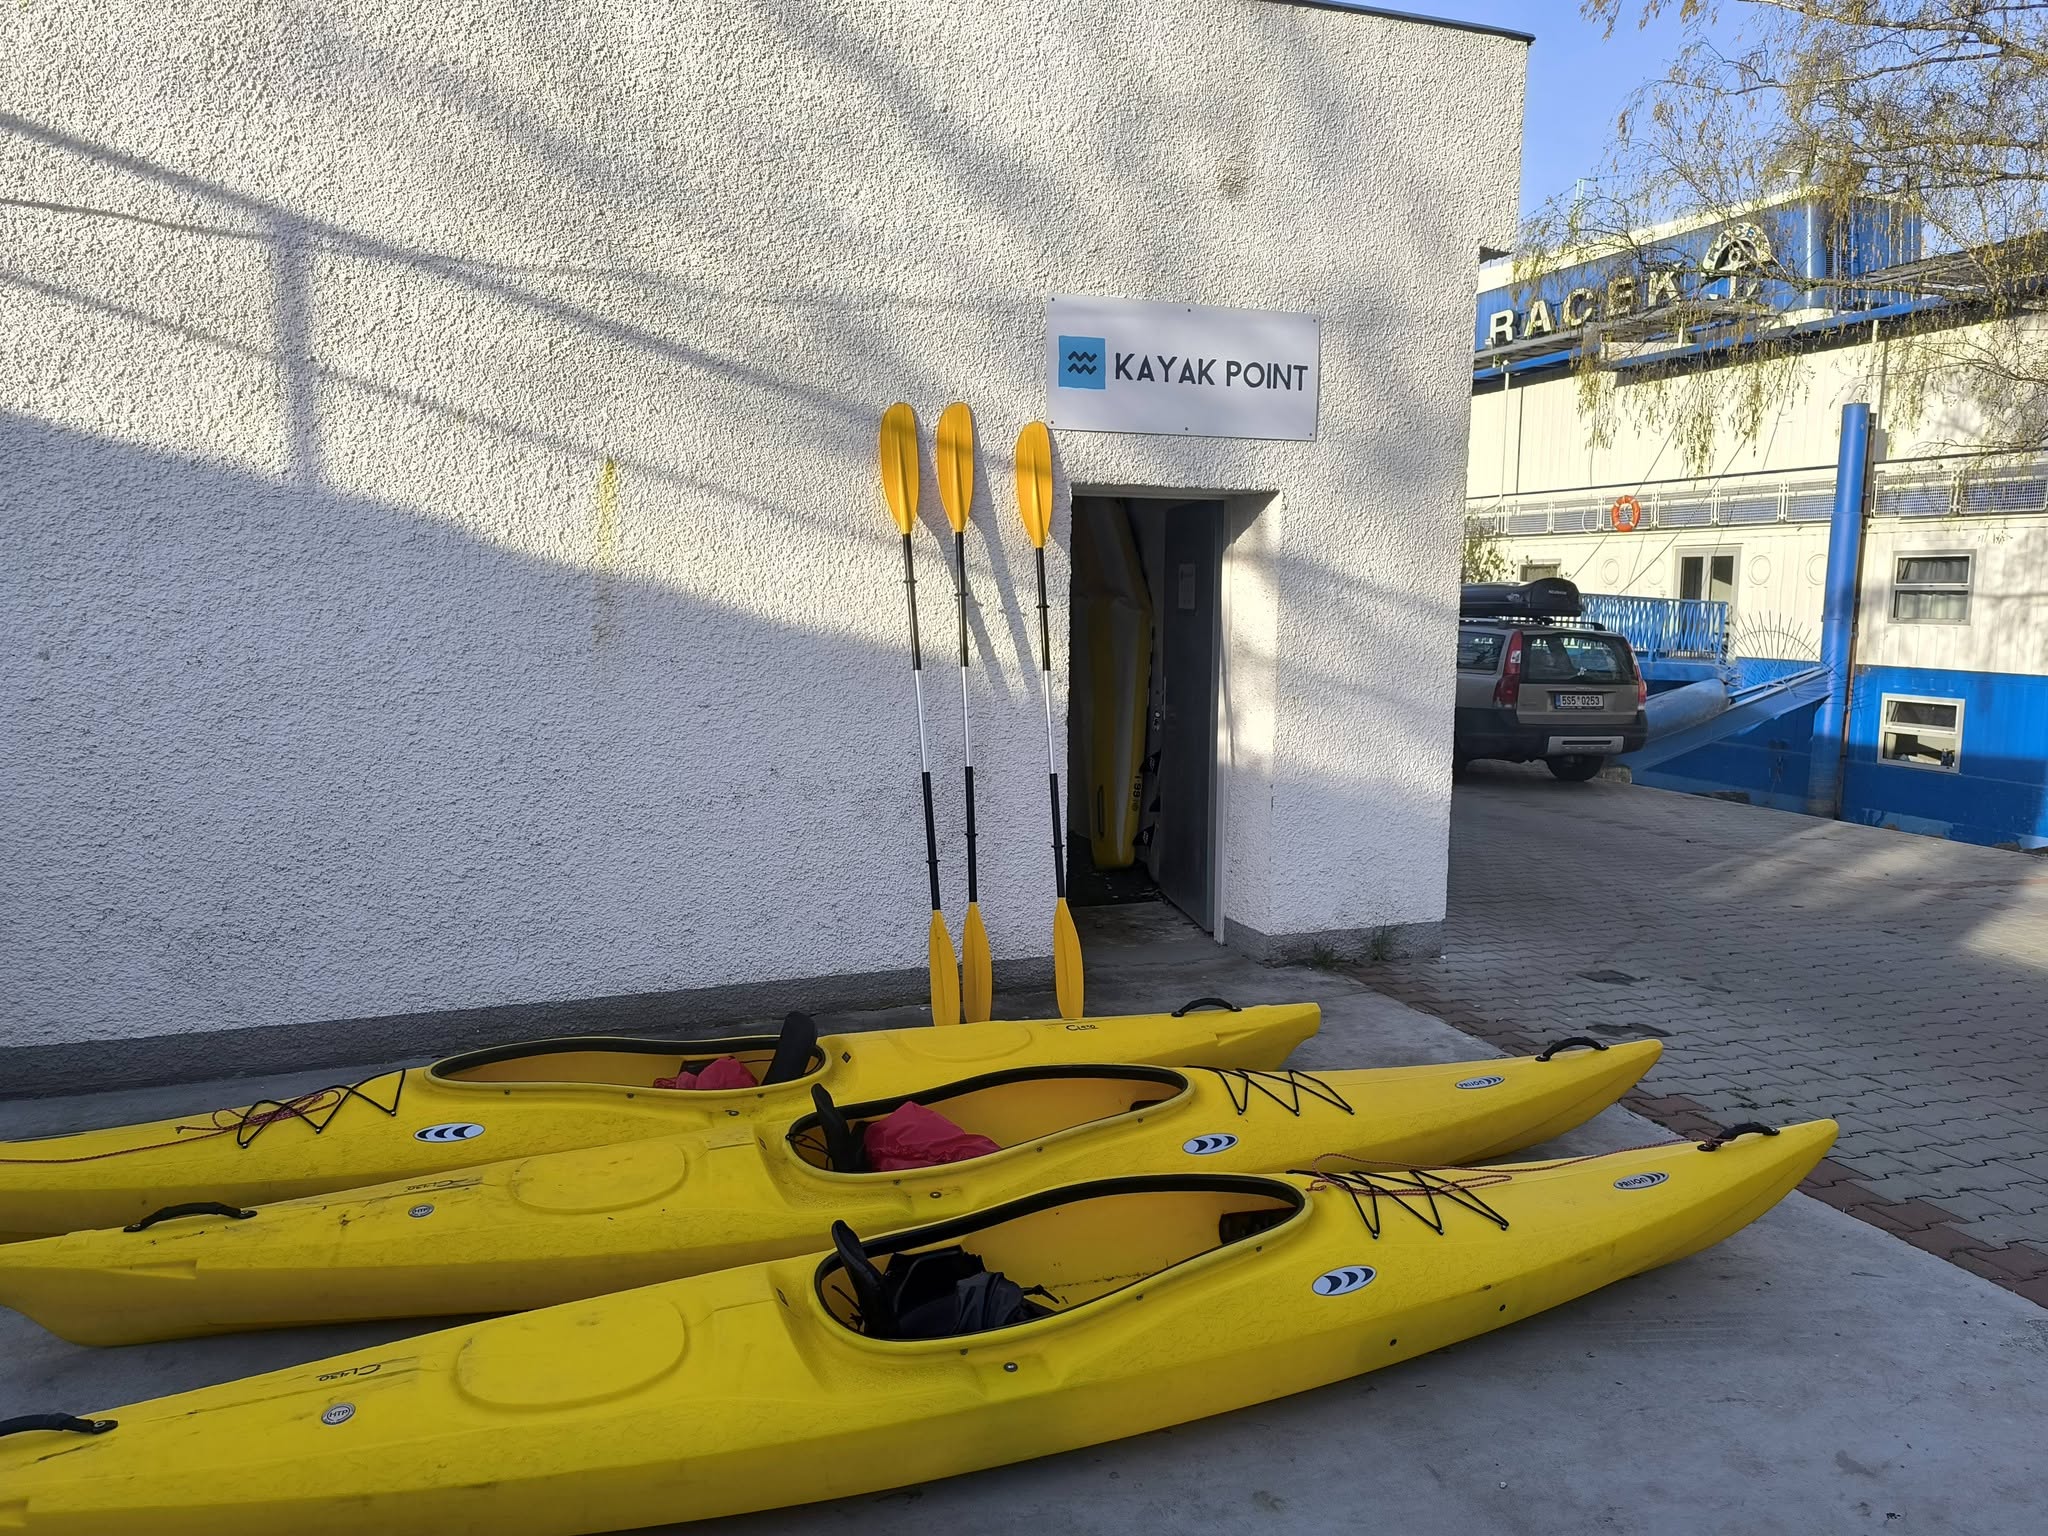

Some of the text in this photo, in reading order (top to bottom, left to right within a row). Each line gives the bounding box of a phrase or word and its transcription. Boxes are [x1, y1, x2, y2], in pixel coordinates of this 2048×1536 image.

[1489, 263, 1682, 344] RACEK
[1115, 352, 1309, 391] KAYAK POINT
[1561, 696, 1600, 705] 5S5 0253
[328, 1409, 348, 1418] HTP
